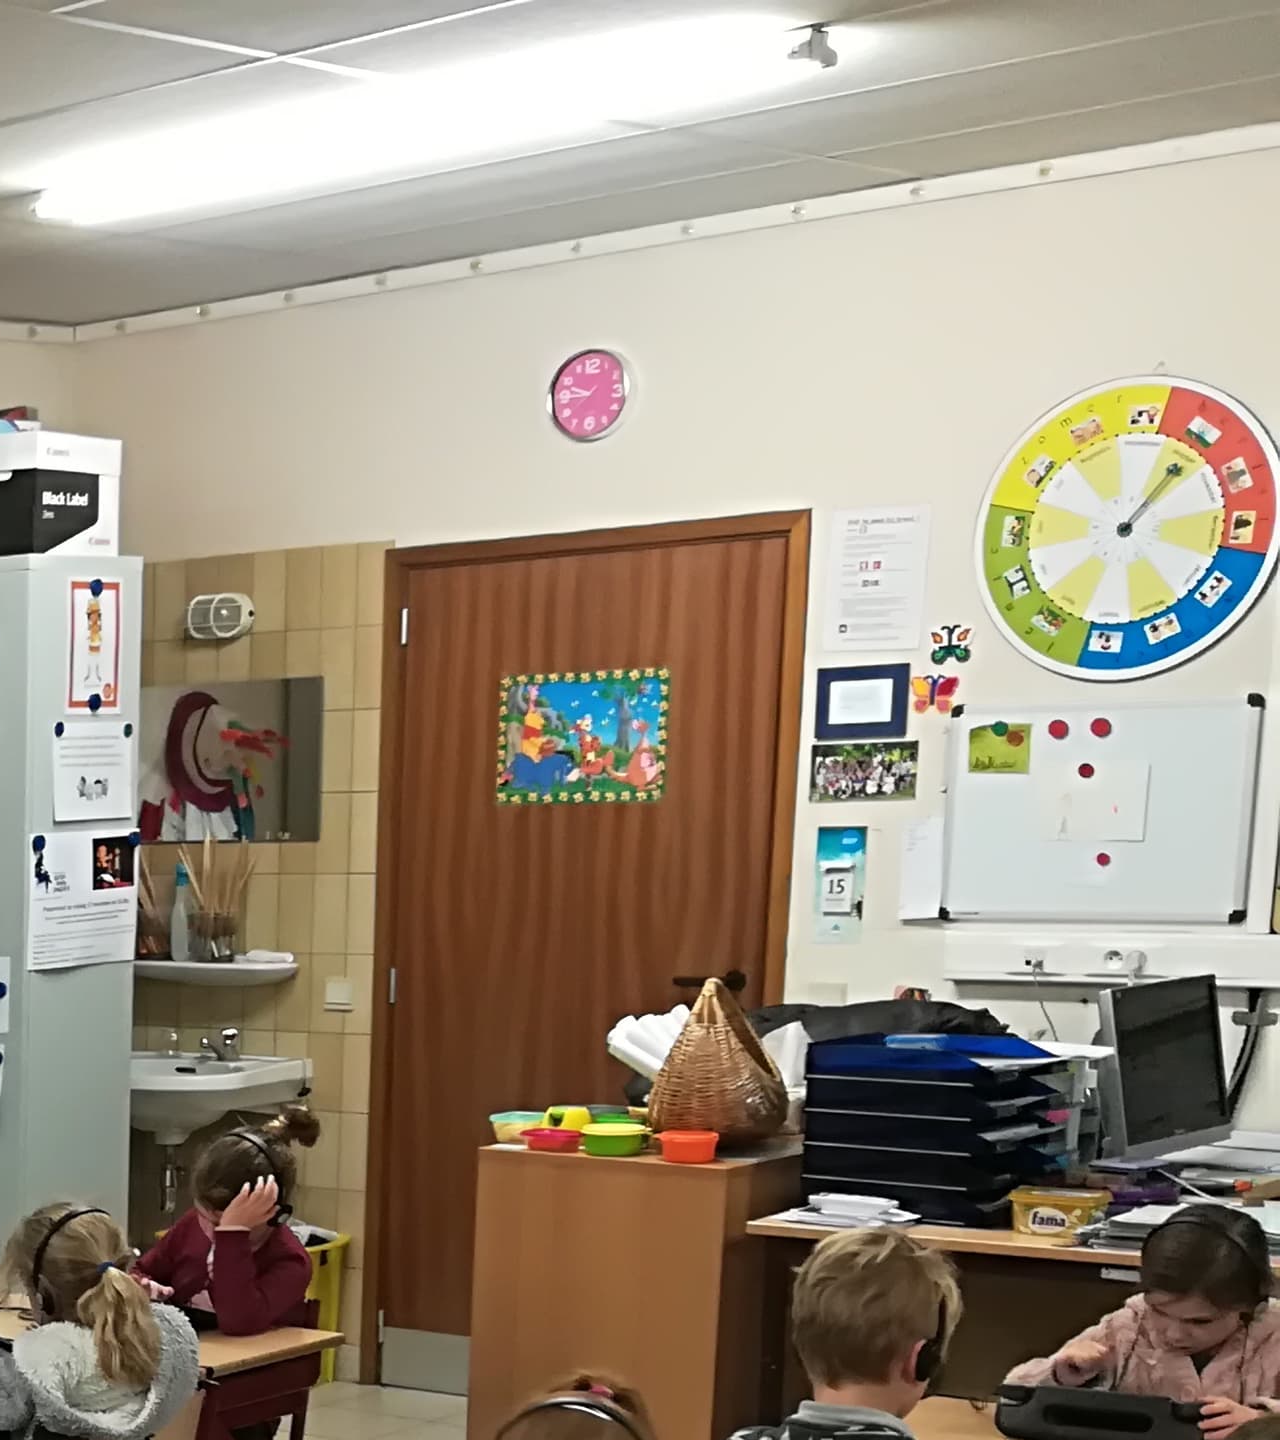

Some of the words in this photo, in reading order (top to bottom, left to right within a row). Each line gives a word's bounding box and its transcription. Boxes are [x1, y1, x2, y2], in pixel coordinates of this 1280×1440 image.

[584, 416, 595, 430] 6
[828, 878, 846, 895] 15
[1031, 1210, 1066, 1228] fama
